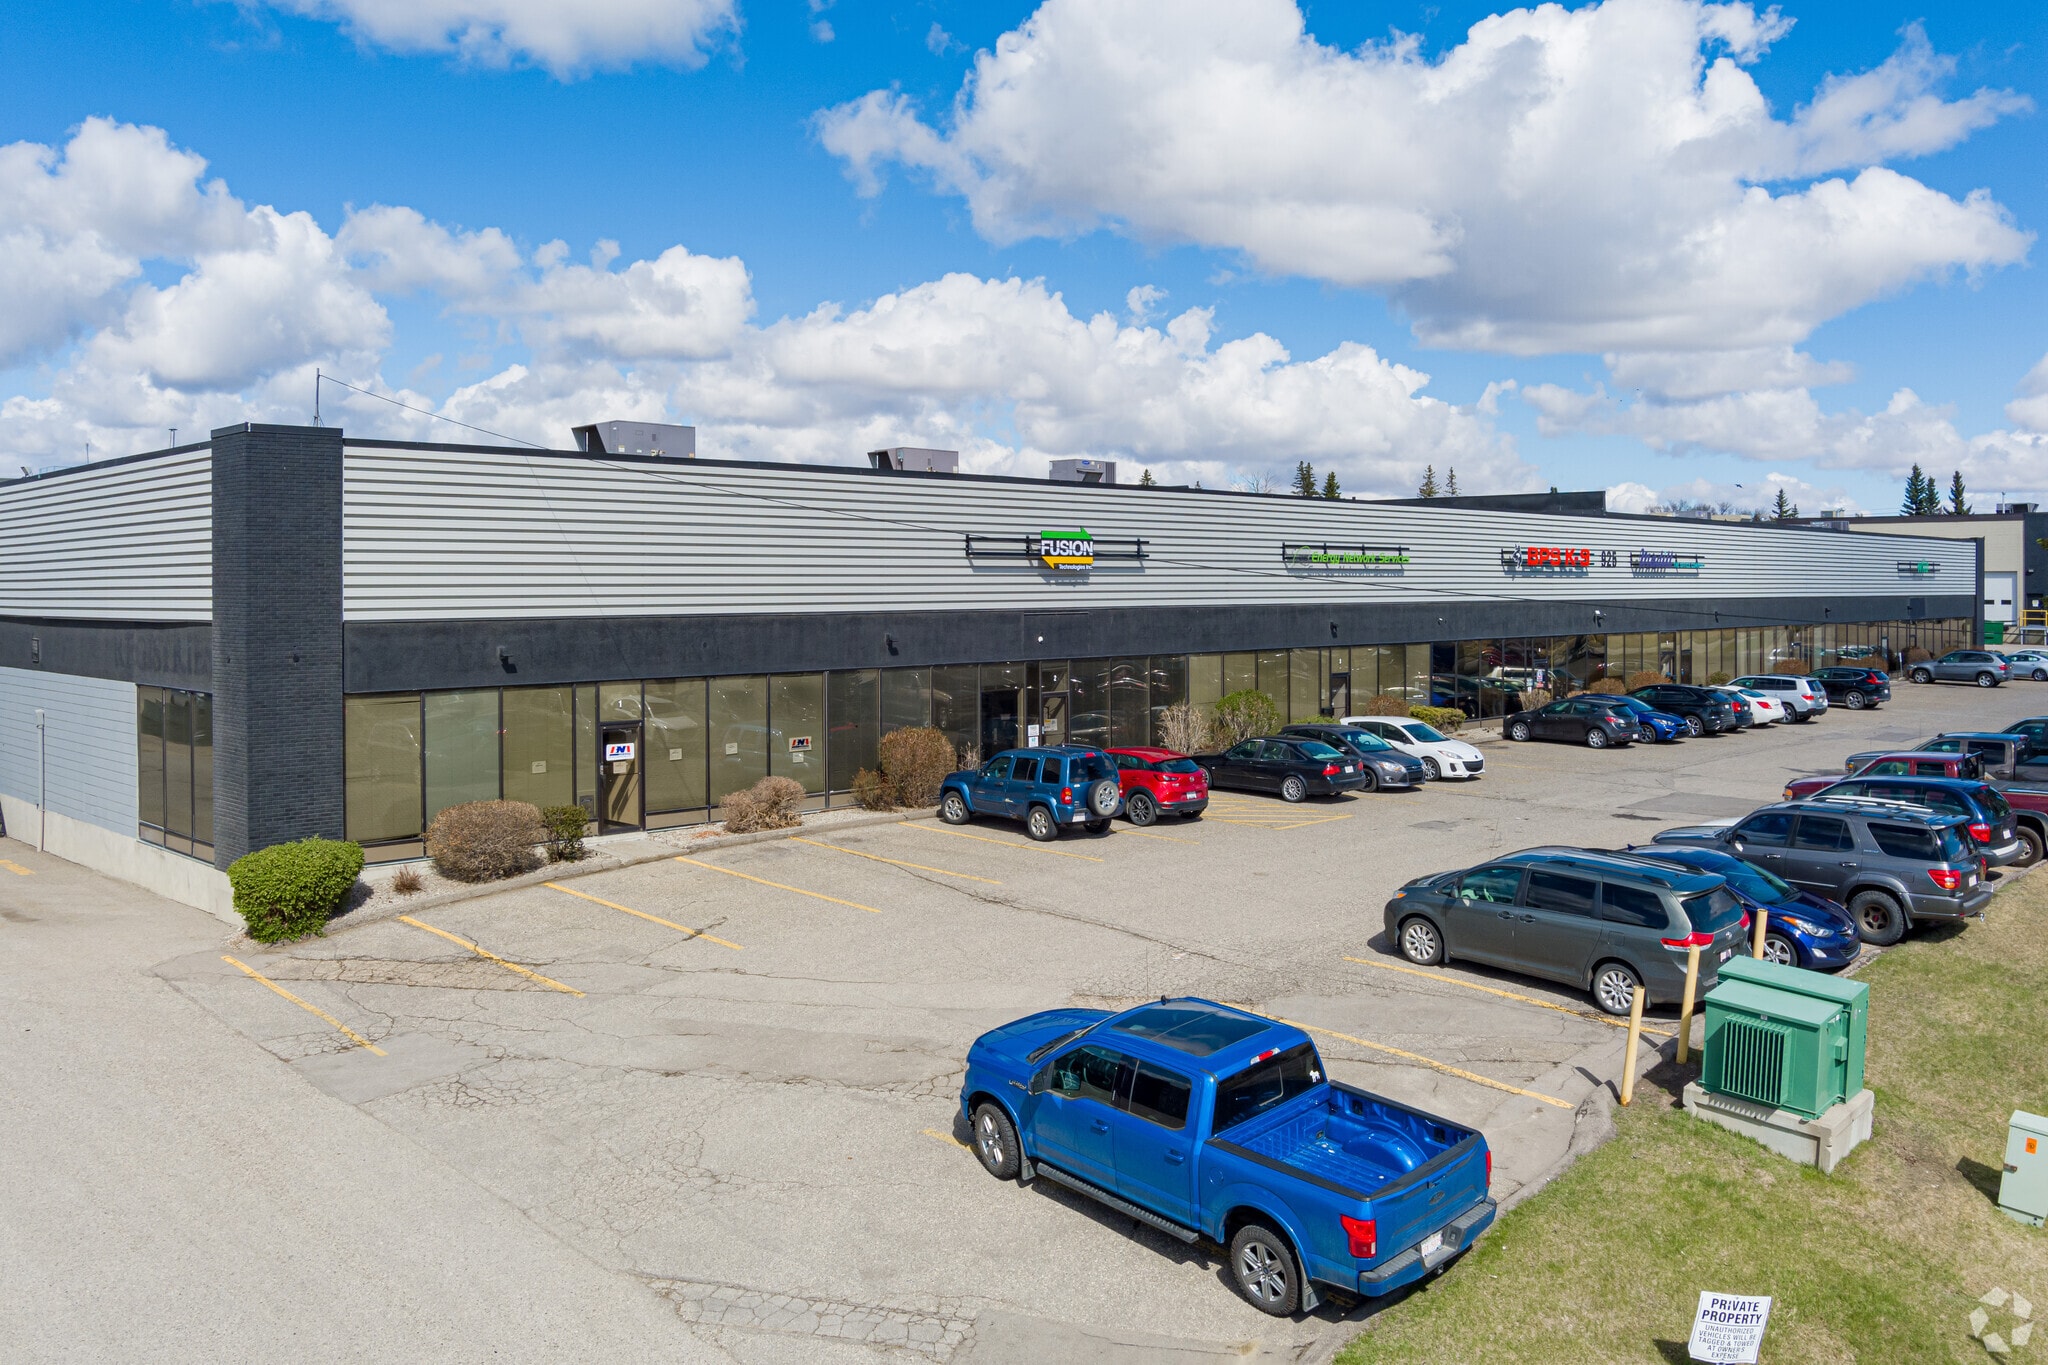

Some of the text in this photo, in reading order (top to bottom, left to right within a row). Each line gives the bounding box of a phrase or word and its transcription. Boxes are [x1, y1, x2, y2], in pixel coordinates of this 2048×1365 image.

[1041, 540, 1093, 556] FUSION
[1312, 552, 1410, 564] Energy Network Services
[1527, 547, 1591, 566] BPS K-9
[1601, 550, 1617, 568] 925
[618, 700, 623, 708] 1
[1711, 1298, 1760, 1312] PRIVATE
[1702, 1310, 1762, 1324] PROPERTY
[1699, 1330, 1731, 1340] VEHICLES
[1705, 1325, 1754, 1334] UNAUTHORIZED
[1698, 1337, 1725, 1346] TAGGED
